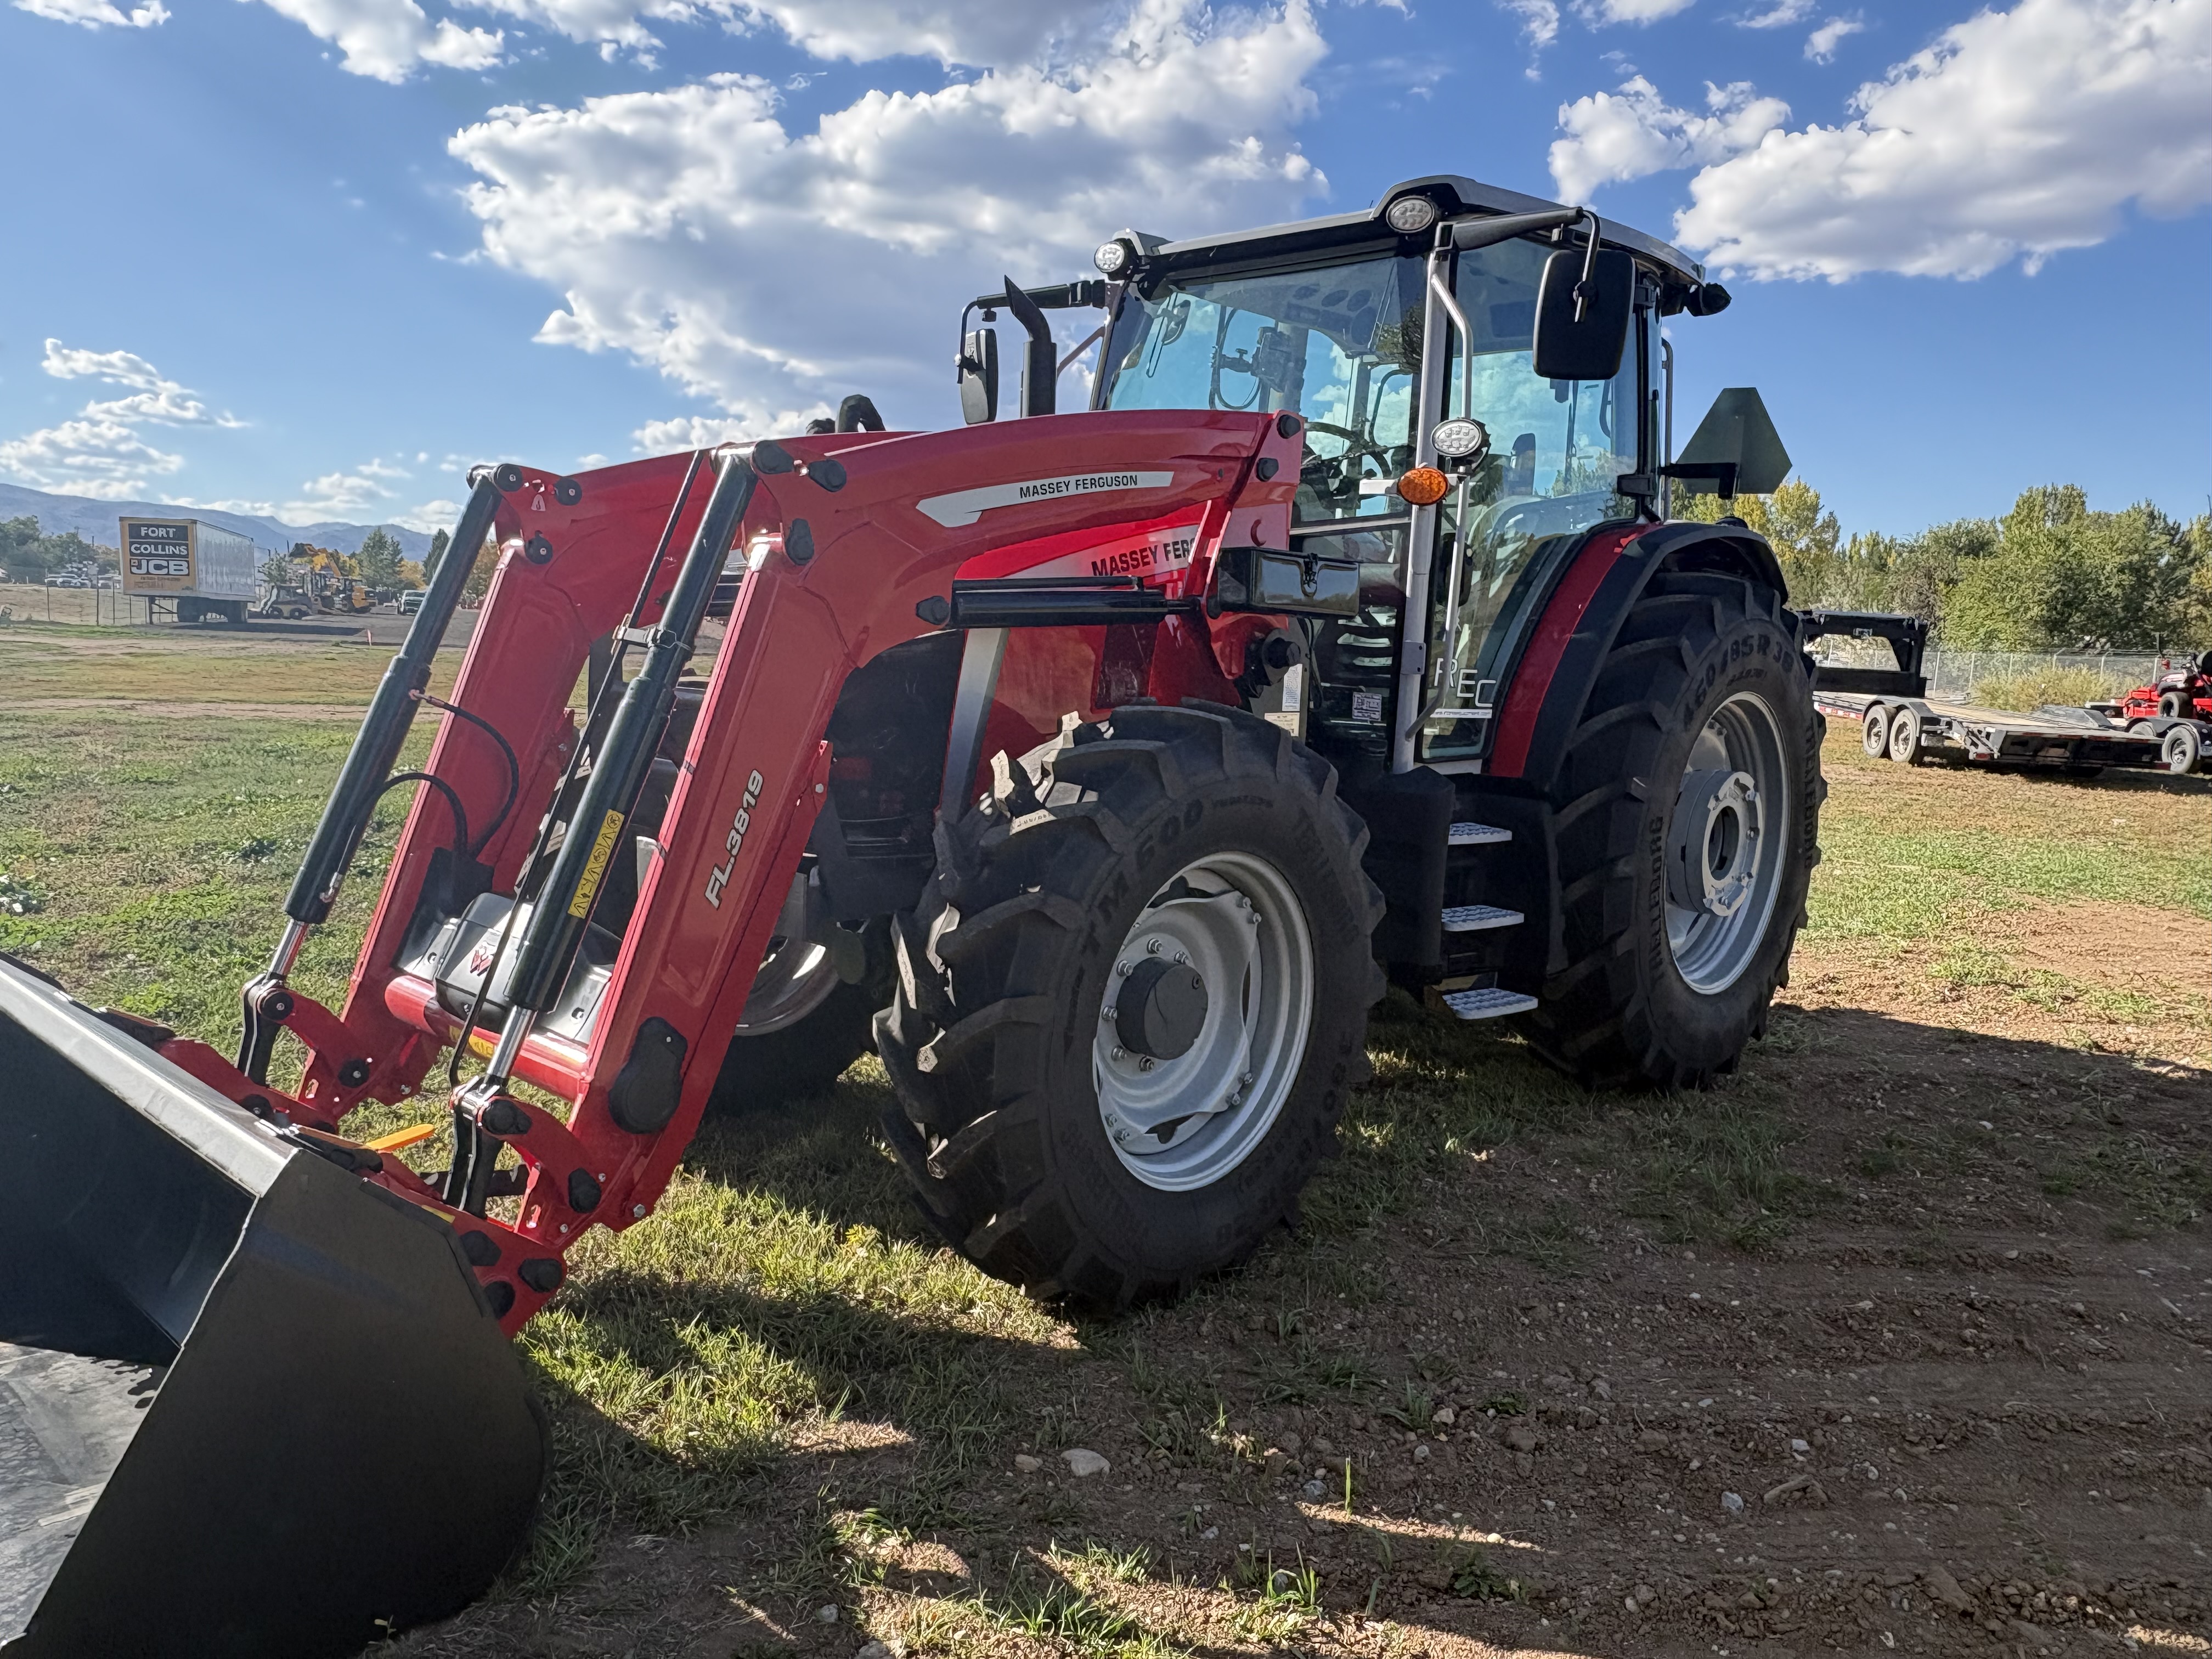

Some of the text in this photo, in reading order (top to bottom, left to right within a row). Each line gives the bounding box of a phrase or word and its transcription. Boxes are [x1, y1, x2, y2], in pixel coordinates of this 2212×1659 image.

[1019, 475, 1138, 499] MASSEY FERGUSON
[140, 527, 176, 538] FORT
[131, 544, 188, 555] COLLINS
[131, 560, 189, 575] JCB
[1091, 545, 1159, 576] MASSEY
